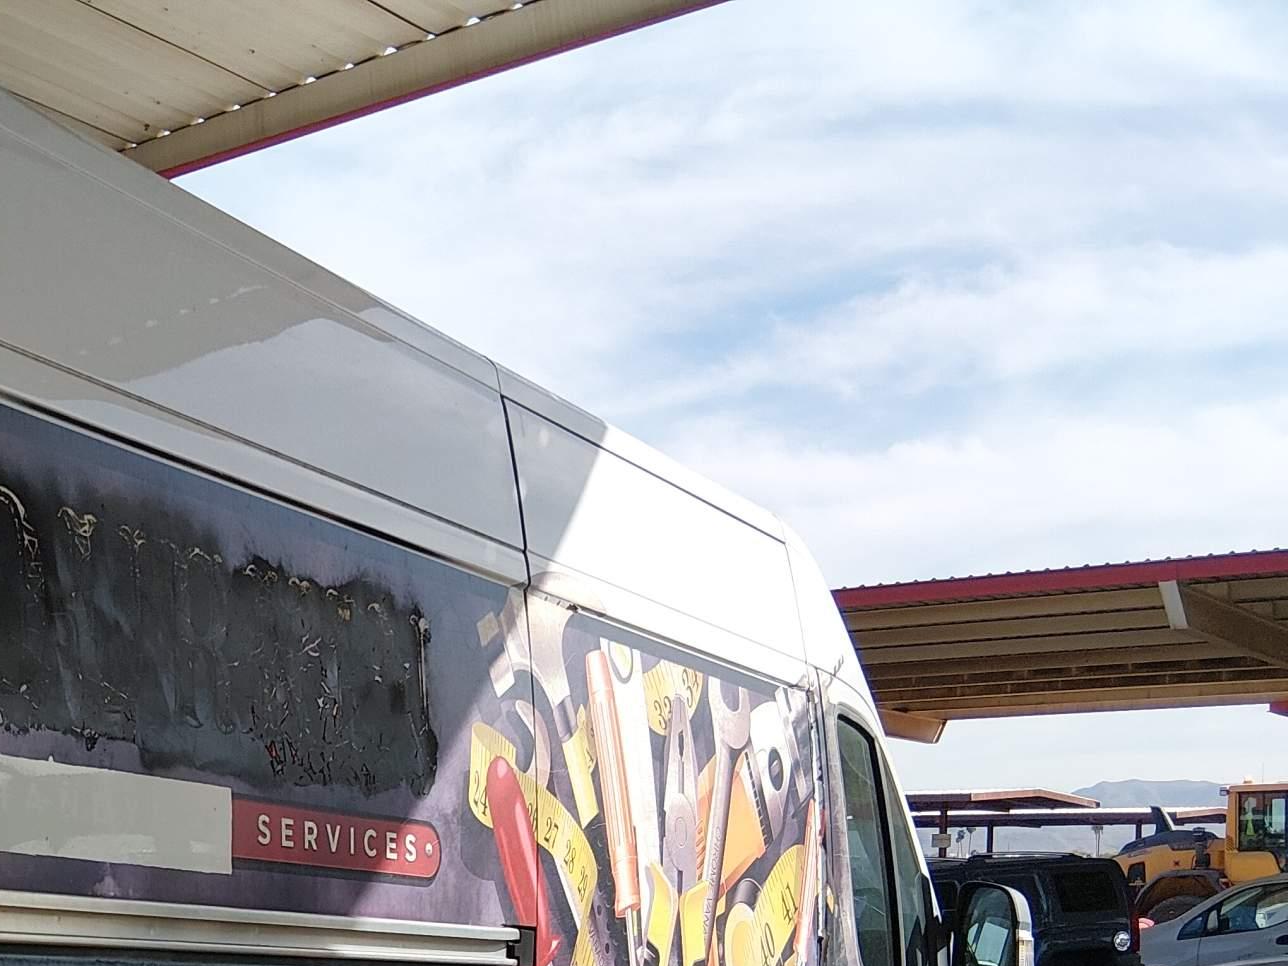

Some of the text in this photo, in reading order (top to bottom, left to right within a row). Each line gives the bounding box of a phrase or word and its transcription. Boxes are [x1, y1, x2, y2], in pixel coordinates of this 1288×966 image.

[257, 814, 417, 862] SERVICES
[543, 816, 559, 849] 27
[563, 839, 577, 874] 28
[577, 866, 588, 903] 29
[780, 883, 798, 925] 41
